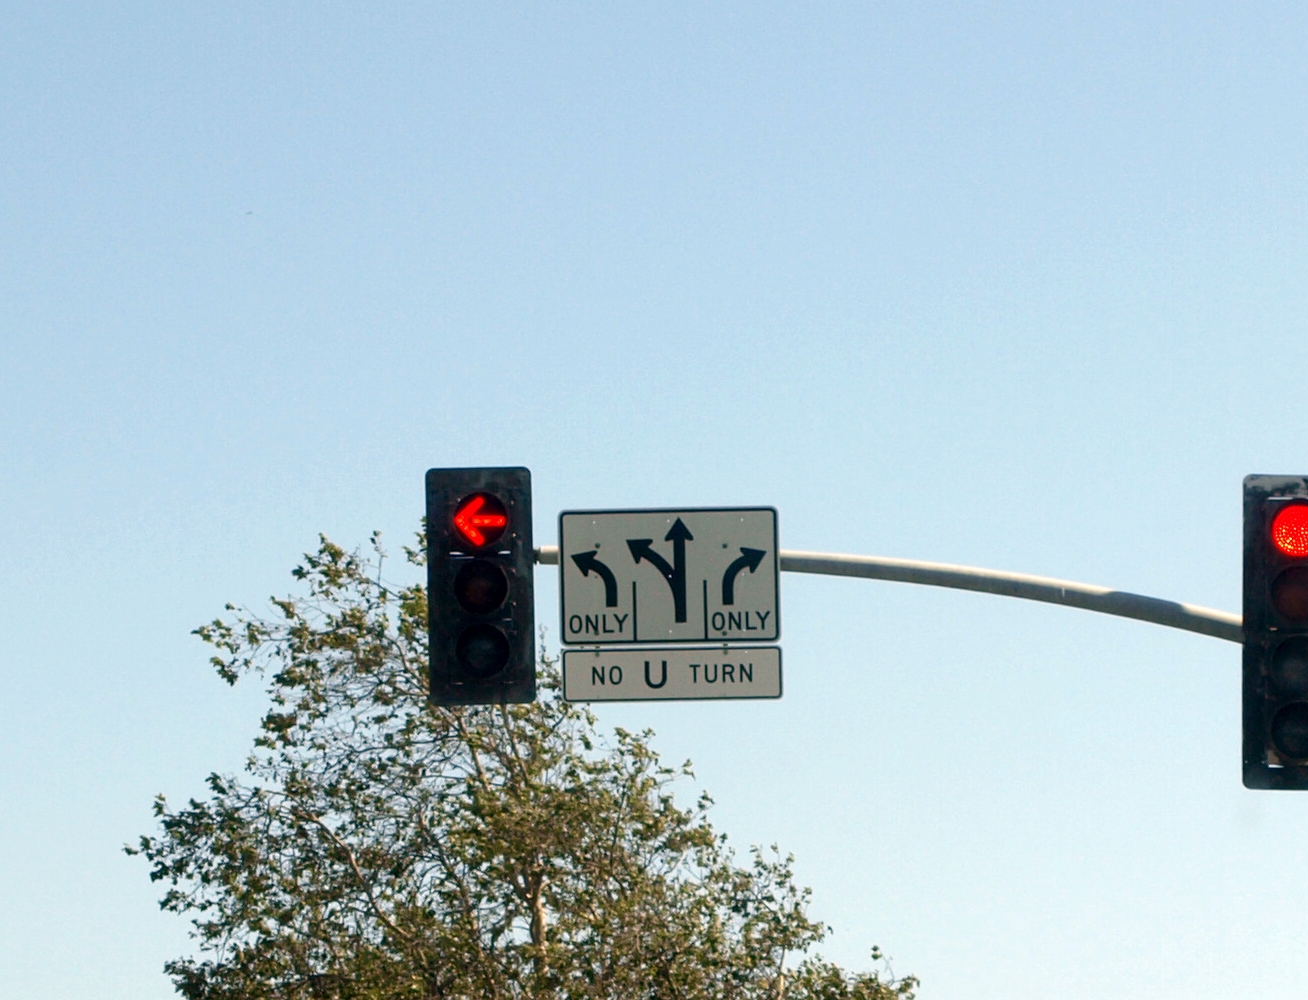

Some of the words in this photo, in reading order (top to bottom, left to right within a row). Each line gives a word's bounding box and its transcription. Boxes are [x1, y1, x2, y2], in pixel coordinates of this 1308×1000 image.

[569, 613, 629, 634] ONLY
[711, 611, 771, 632] ONLY
[591, 665, 623, 686] NO
[644, 660, 668, 689] U
[689, 663, 753, 684] TURN
